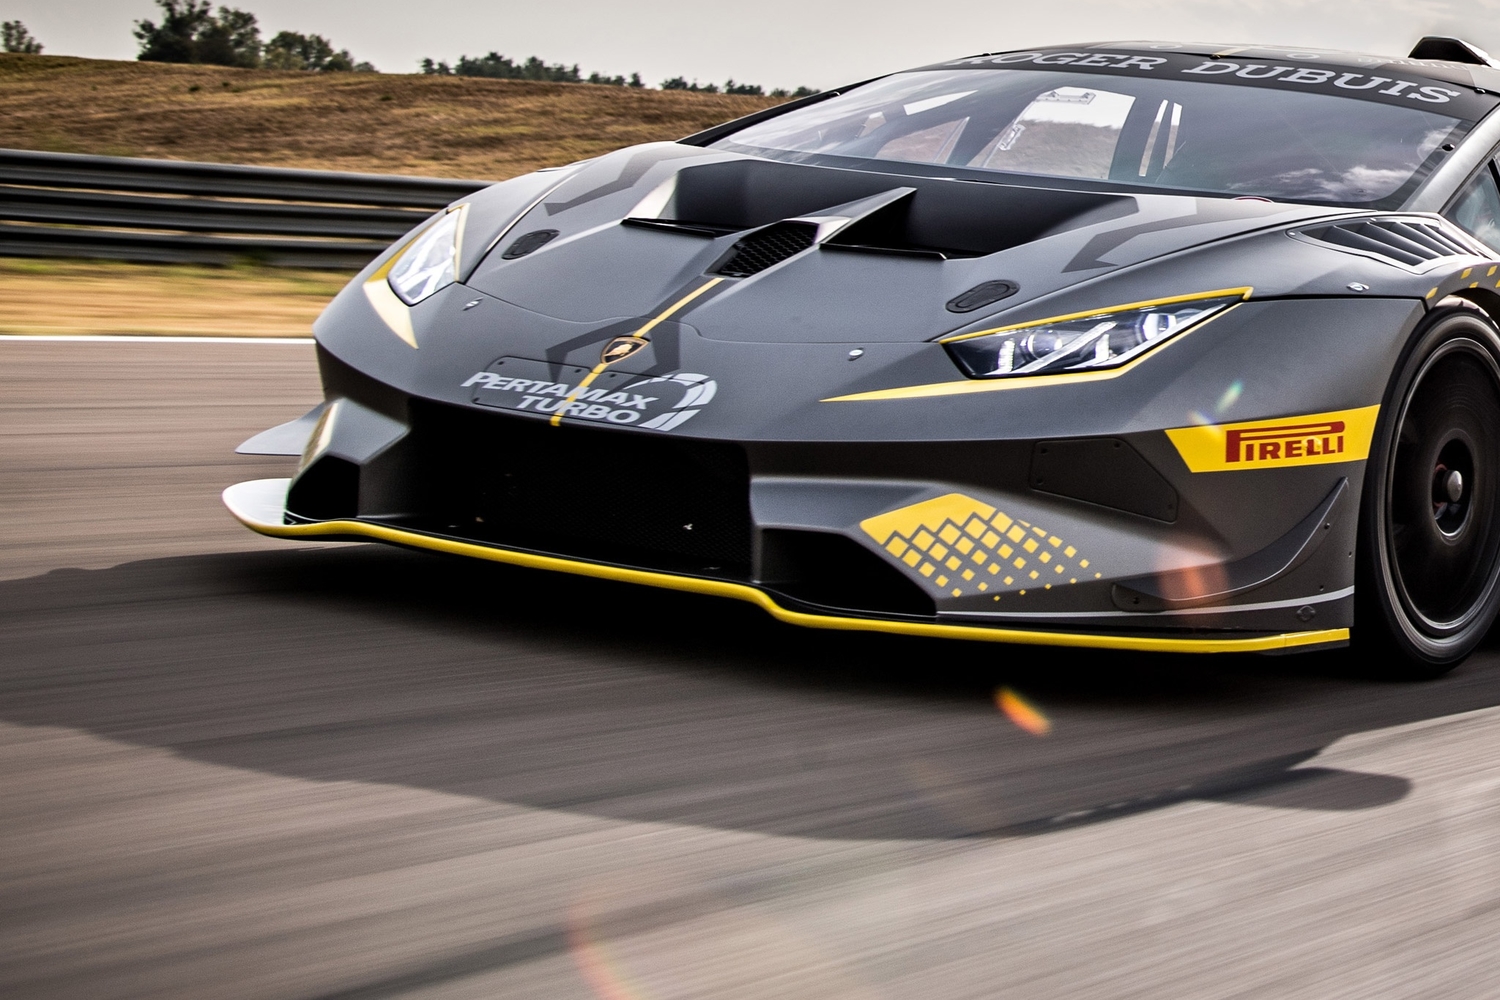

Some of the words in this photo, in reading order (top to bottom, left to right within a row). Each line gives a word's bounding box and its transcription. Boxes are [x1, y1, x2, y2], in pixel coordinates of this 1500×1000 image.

[946, 52, 1168, 70] ROGER
[1181, 61, 1462, 103] DUBUIS
[460, 371, 659, 410] PERTAMAX
[517, 395, 641, 424] TURBO
[1225, 420, 1345, 463] PIRELLI
